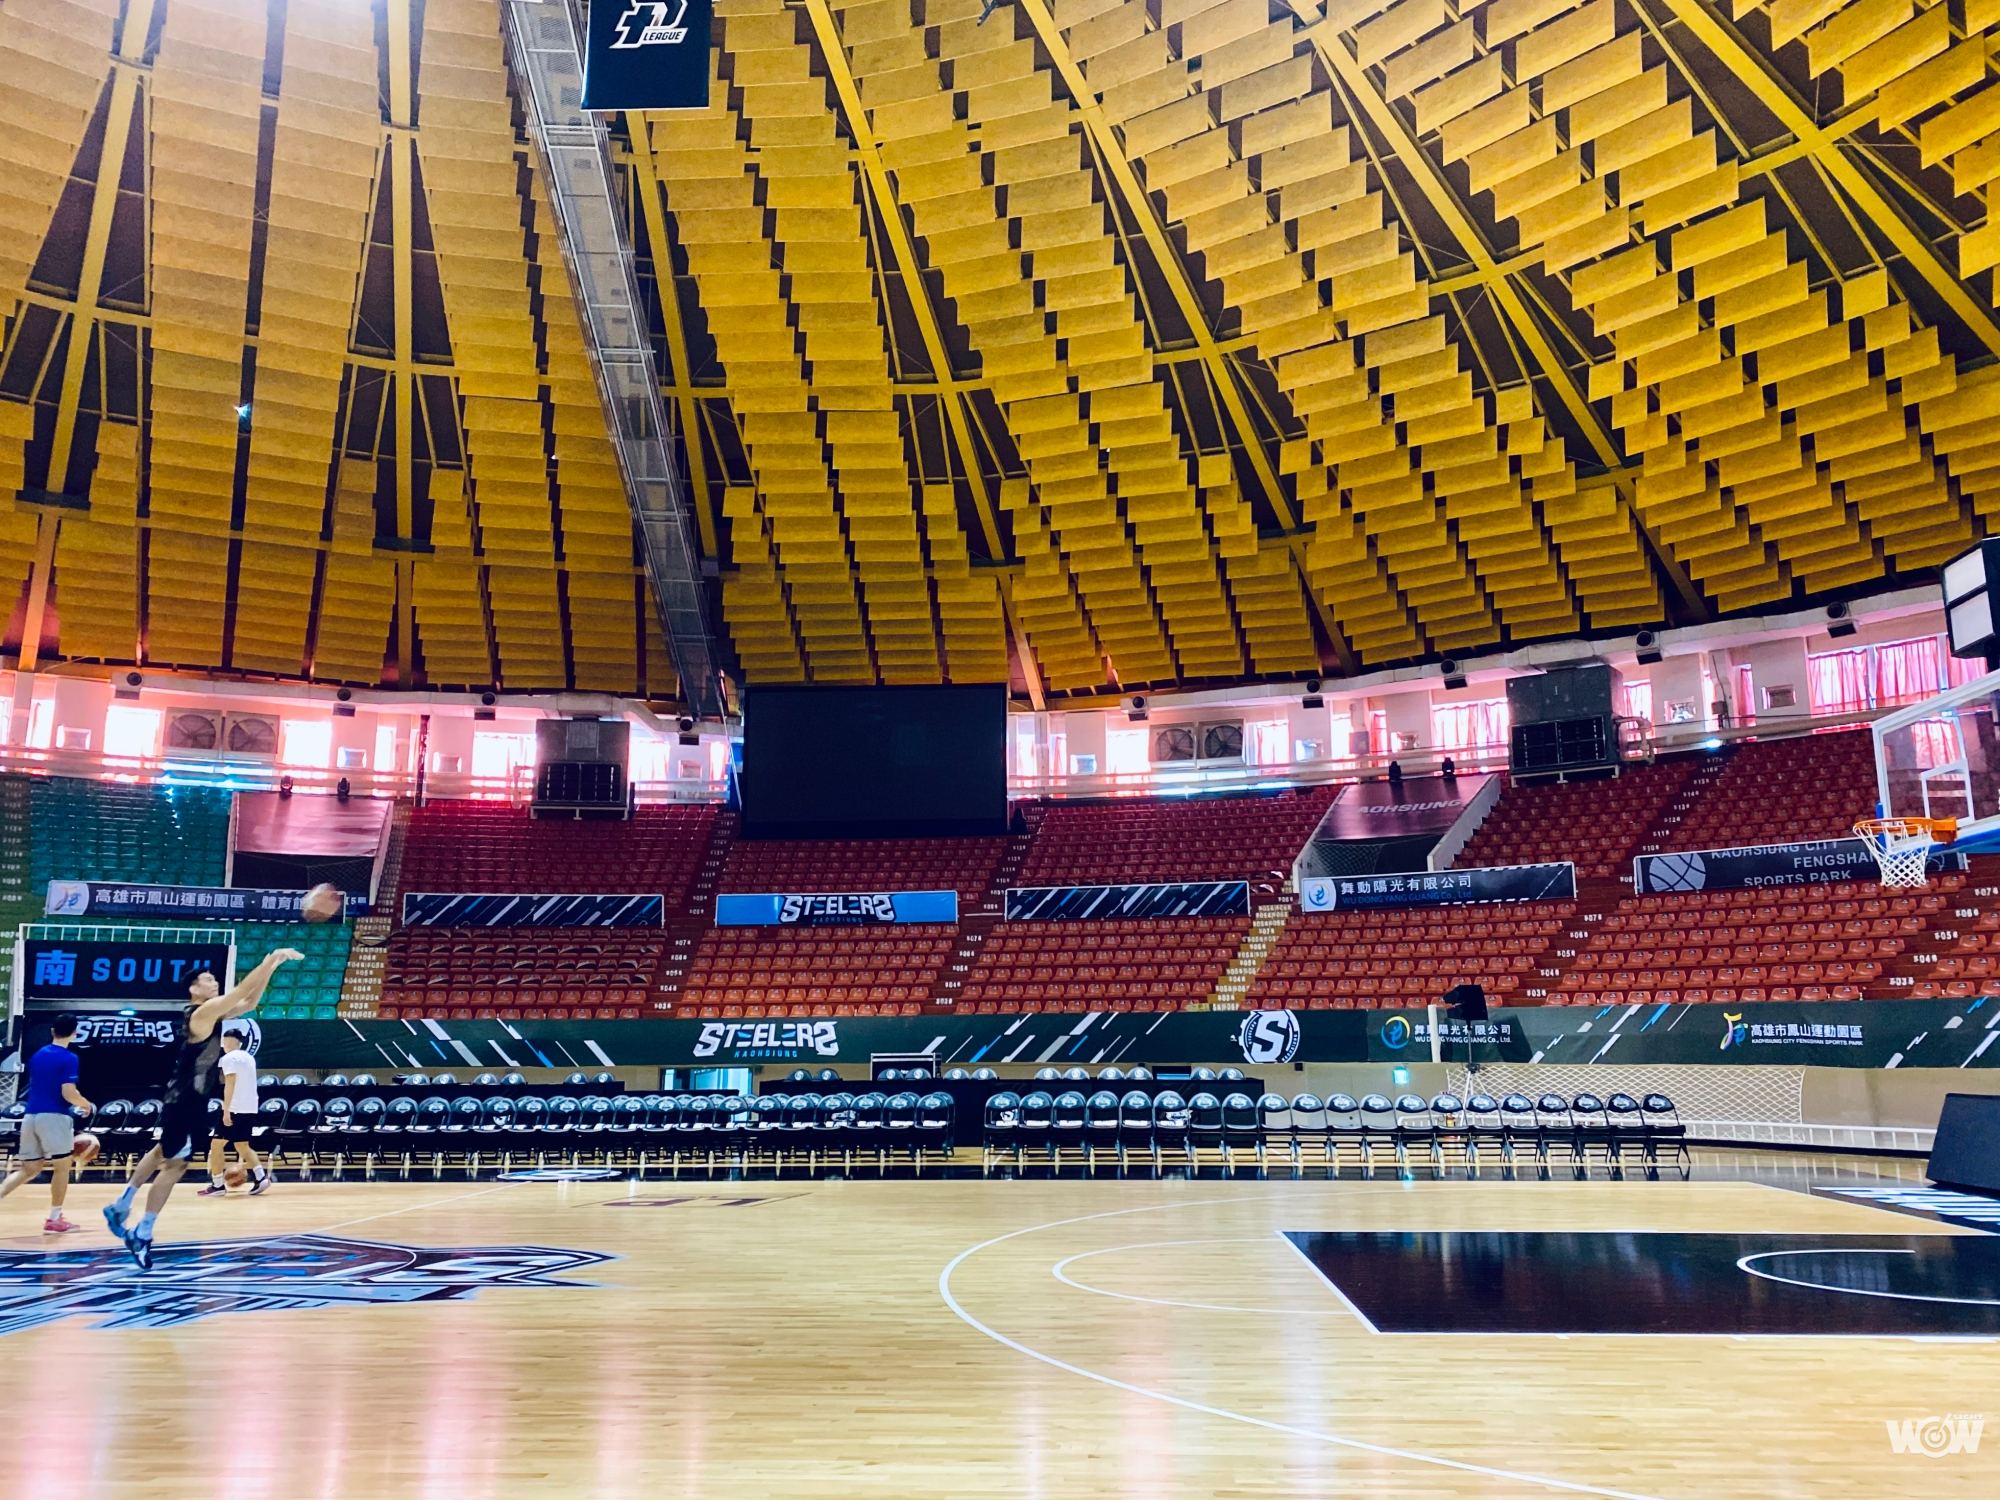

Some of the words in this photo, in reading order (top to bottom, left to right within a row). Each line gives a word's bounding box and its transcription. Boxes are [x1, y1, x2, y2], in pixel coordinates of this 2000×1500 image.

[643, 31, 682, 41] LEAGUE
[1341, 875, 1472, 895] 舞動陽光有限公司
[1810, 869, 1852, 881] PARK
[780, 894, 895, 922] STEELERS
[34, 950, 77, 985] 南
[70, 1020, 175, 1043] STEELERS
[693, 1020, 840, 1057] STEELERS
[1751, 1023, 1863, 1038] 高雄市鳳山運動園區
